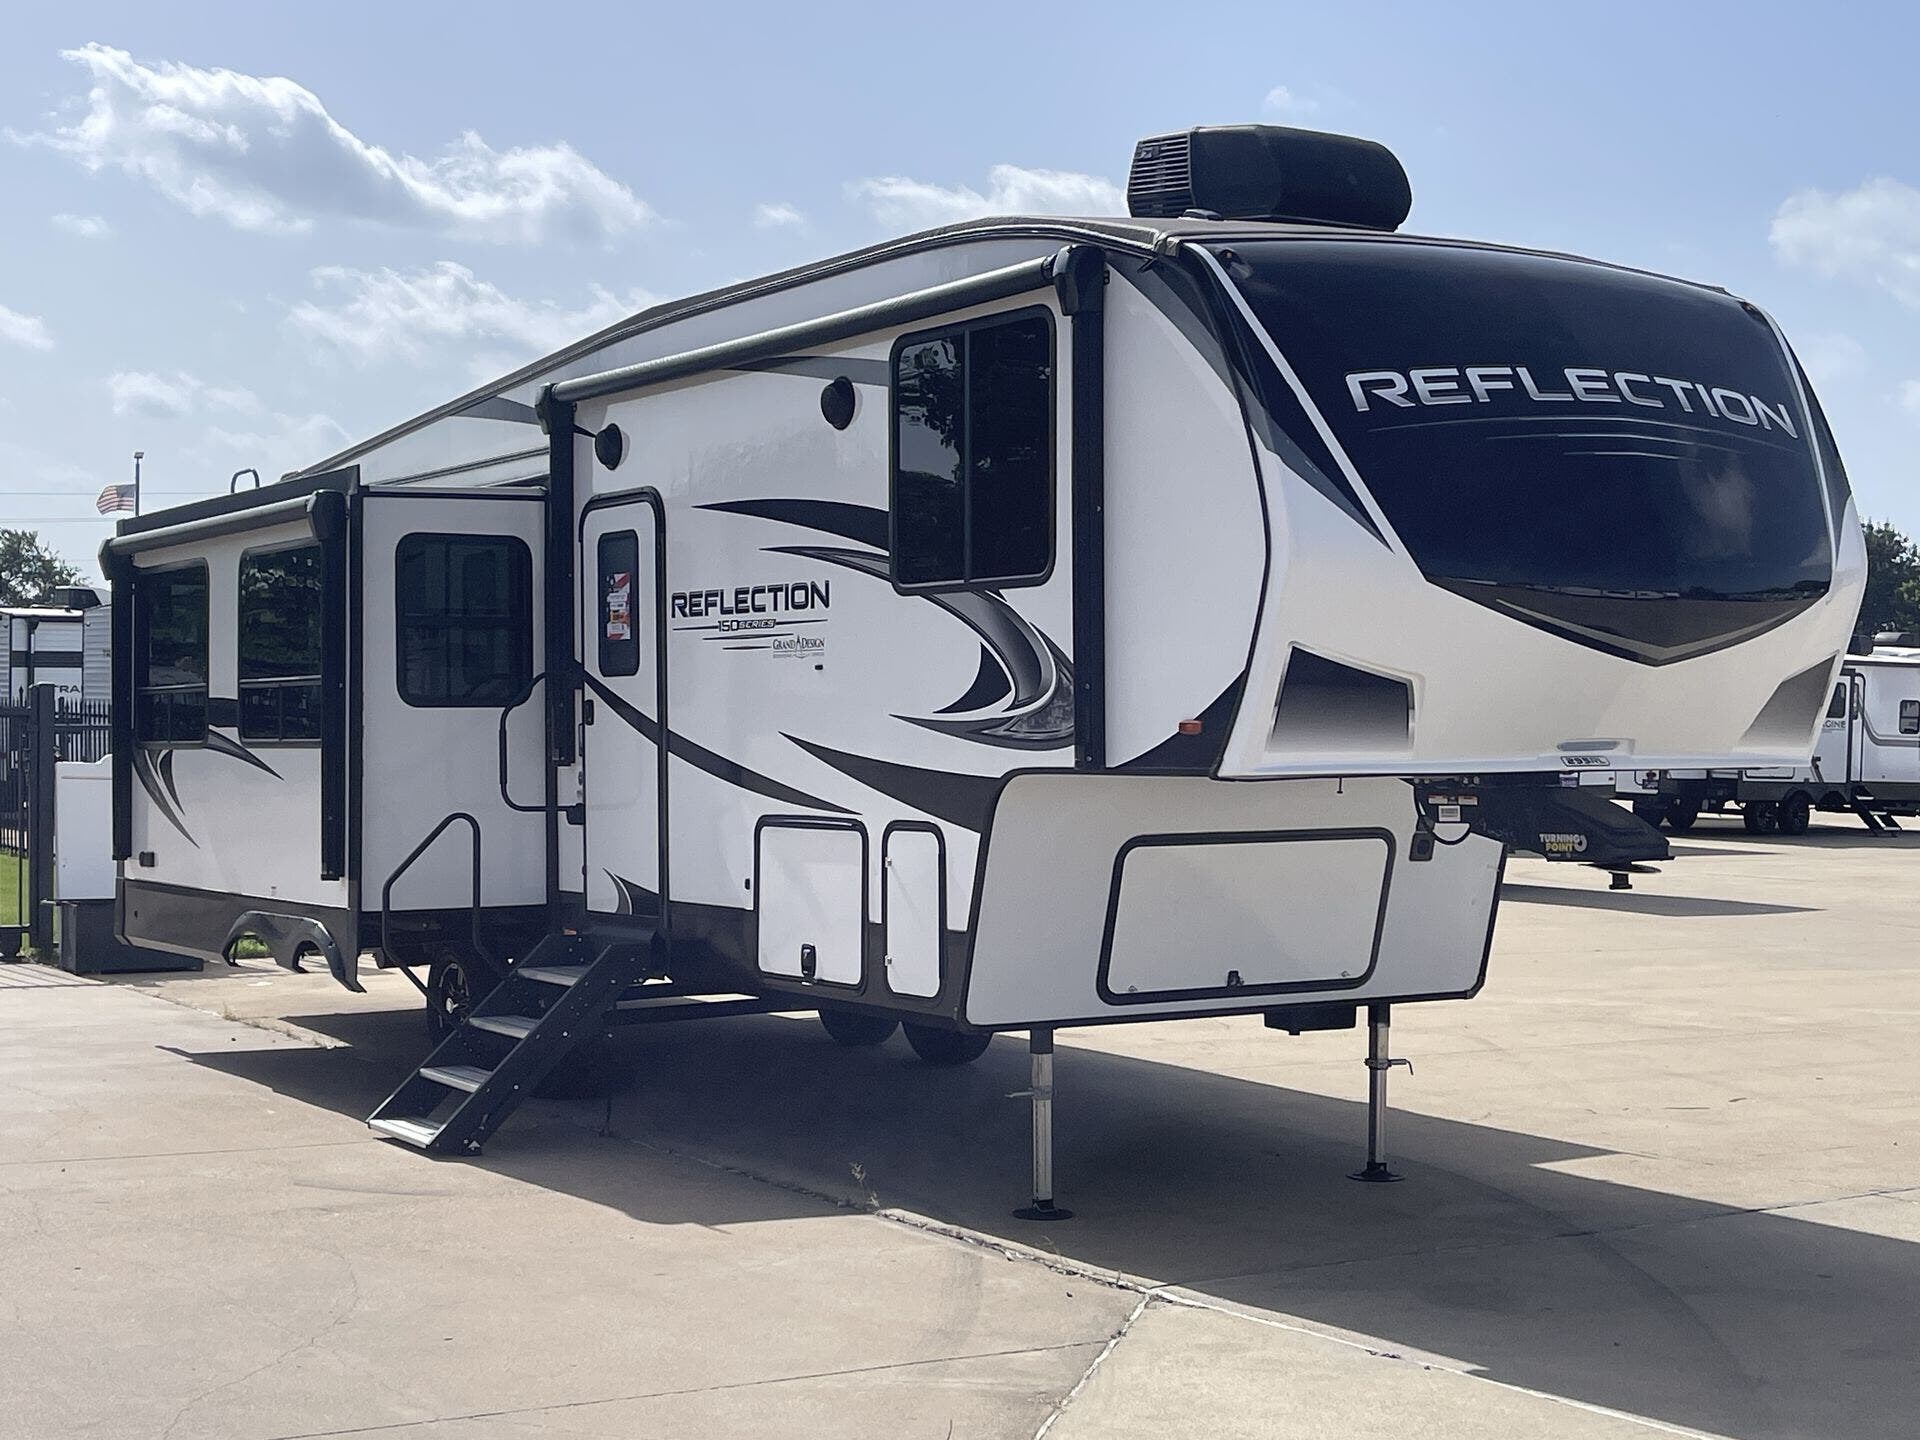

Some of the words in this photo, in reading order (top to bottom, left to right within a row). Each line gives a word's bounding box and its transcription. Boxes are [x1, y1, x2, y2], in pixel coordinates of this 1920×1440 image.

[1345, 366, 1799, 440] REFLECTION
[671, 580, 830, 618] REFLECTION
[1539, 833, 1580, 843] TURNING
[1545, 842, 1574, 852] POINT
